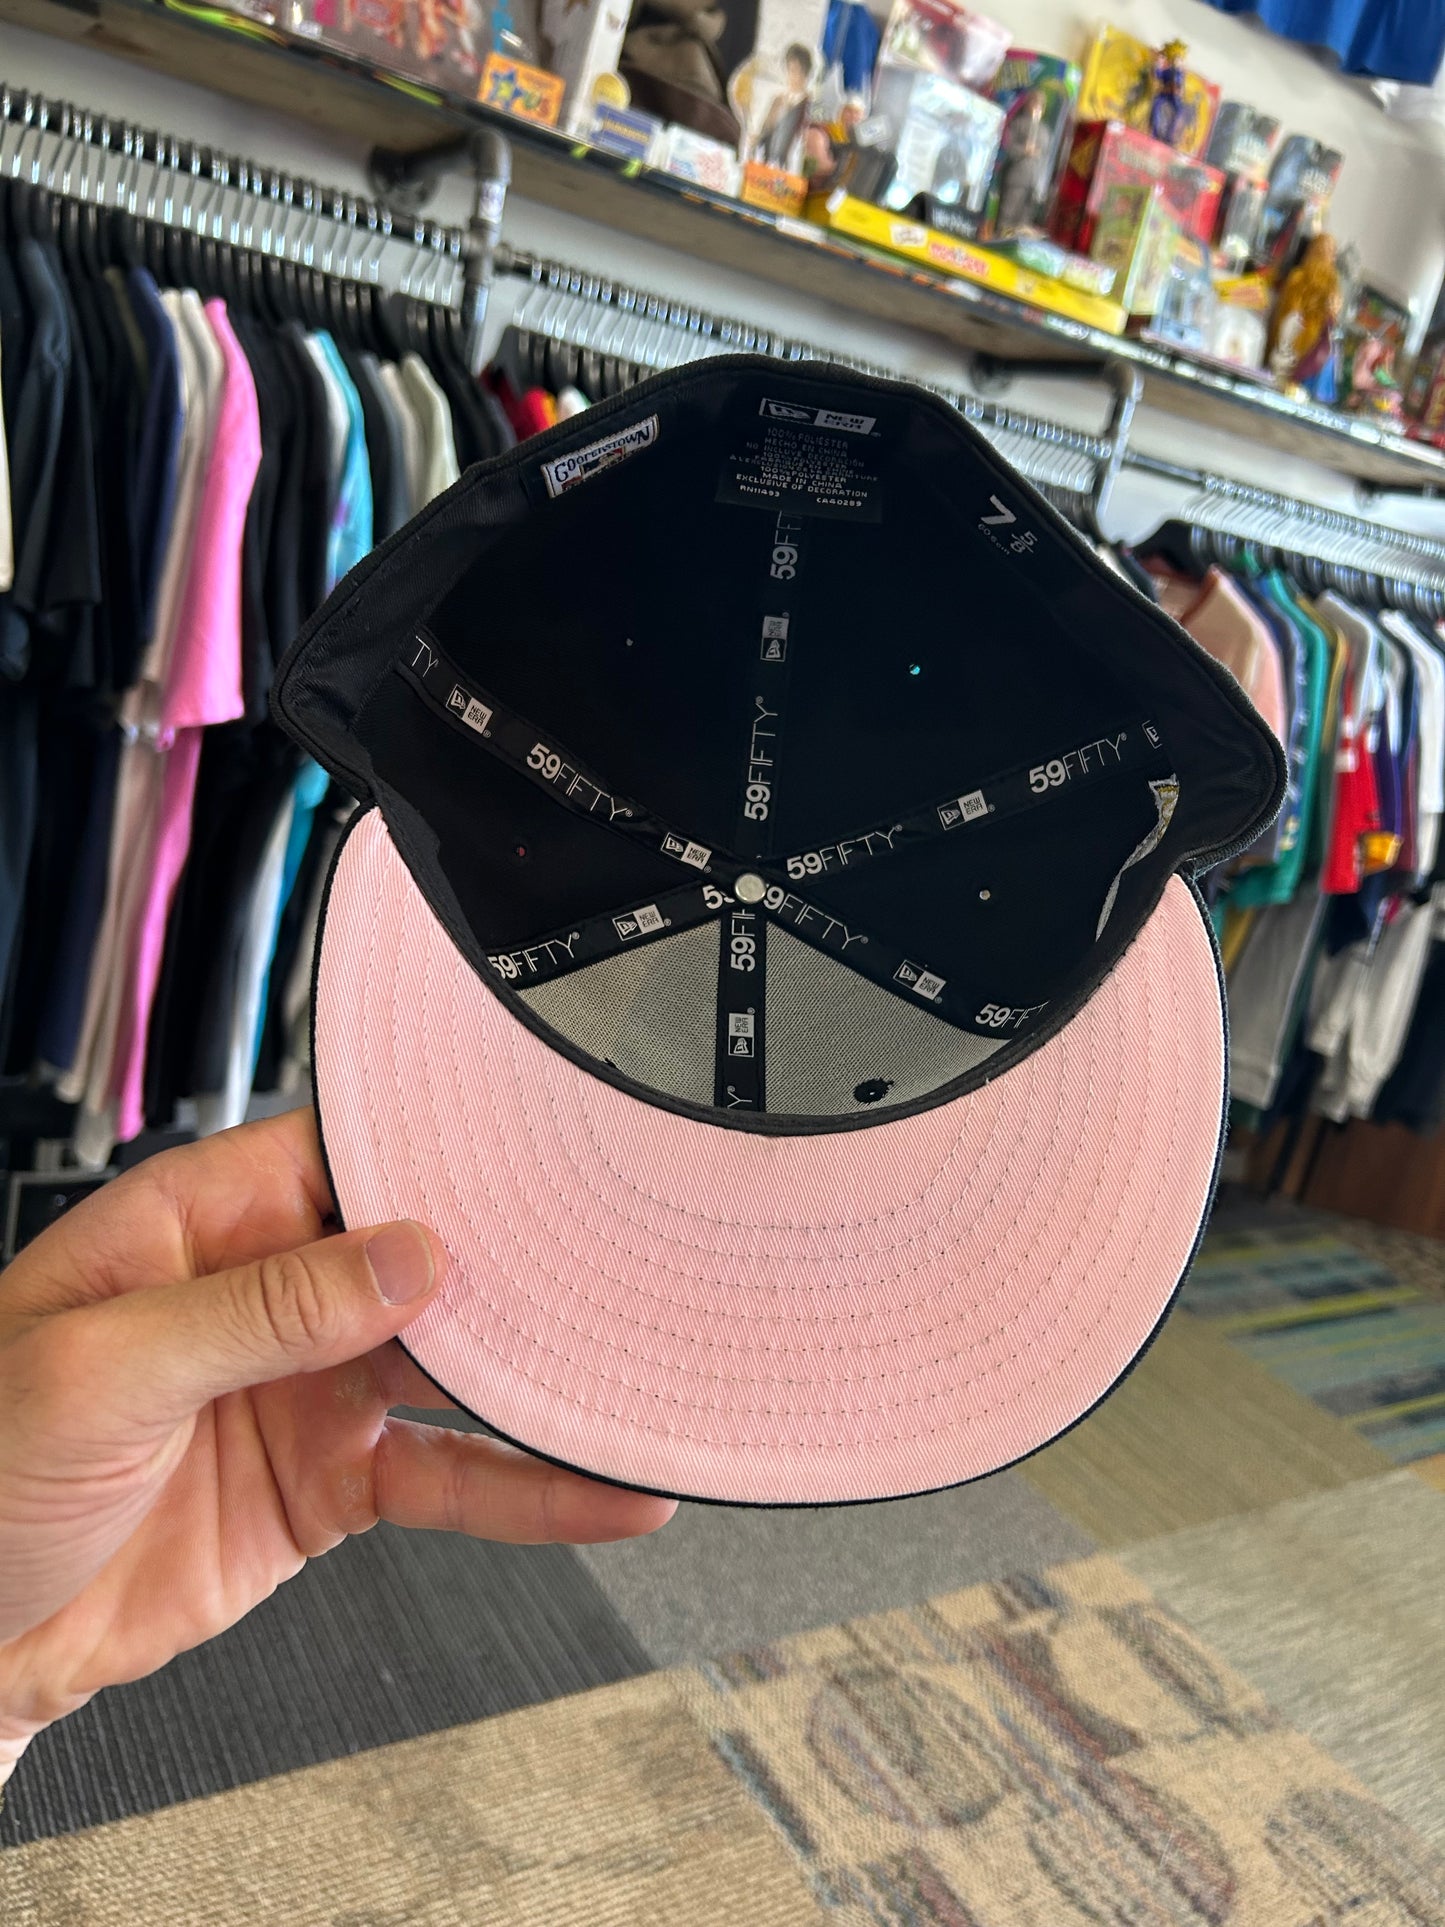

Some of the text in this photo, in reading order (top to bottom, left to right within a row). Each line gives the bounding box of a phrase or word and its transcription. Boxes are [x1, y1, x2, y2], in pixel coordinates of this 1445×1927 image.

[764, 437, 798, 449] HECHO
[736, 473, 868, 498] EXCLUSIVE OF DECORATION
[762, 472, 792, 482] MADE
[812, 480, 843, 489] CHINA
[792, 470, 847, 483] POLYESTER
[980, 494, 1017, 525] 7
[762, 884, 864, 950] 9FIFTY
